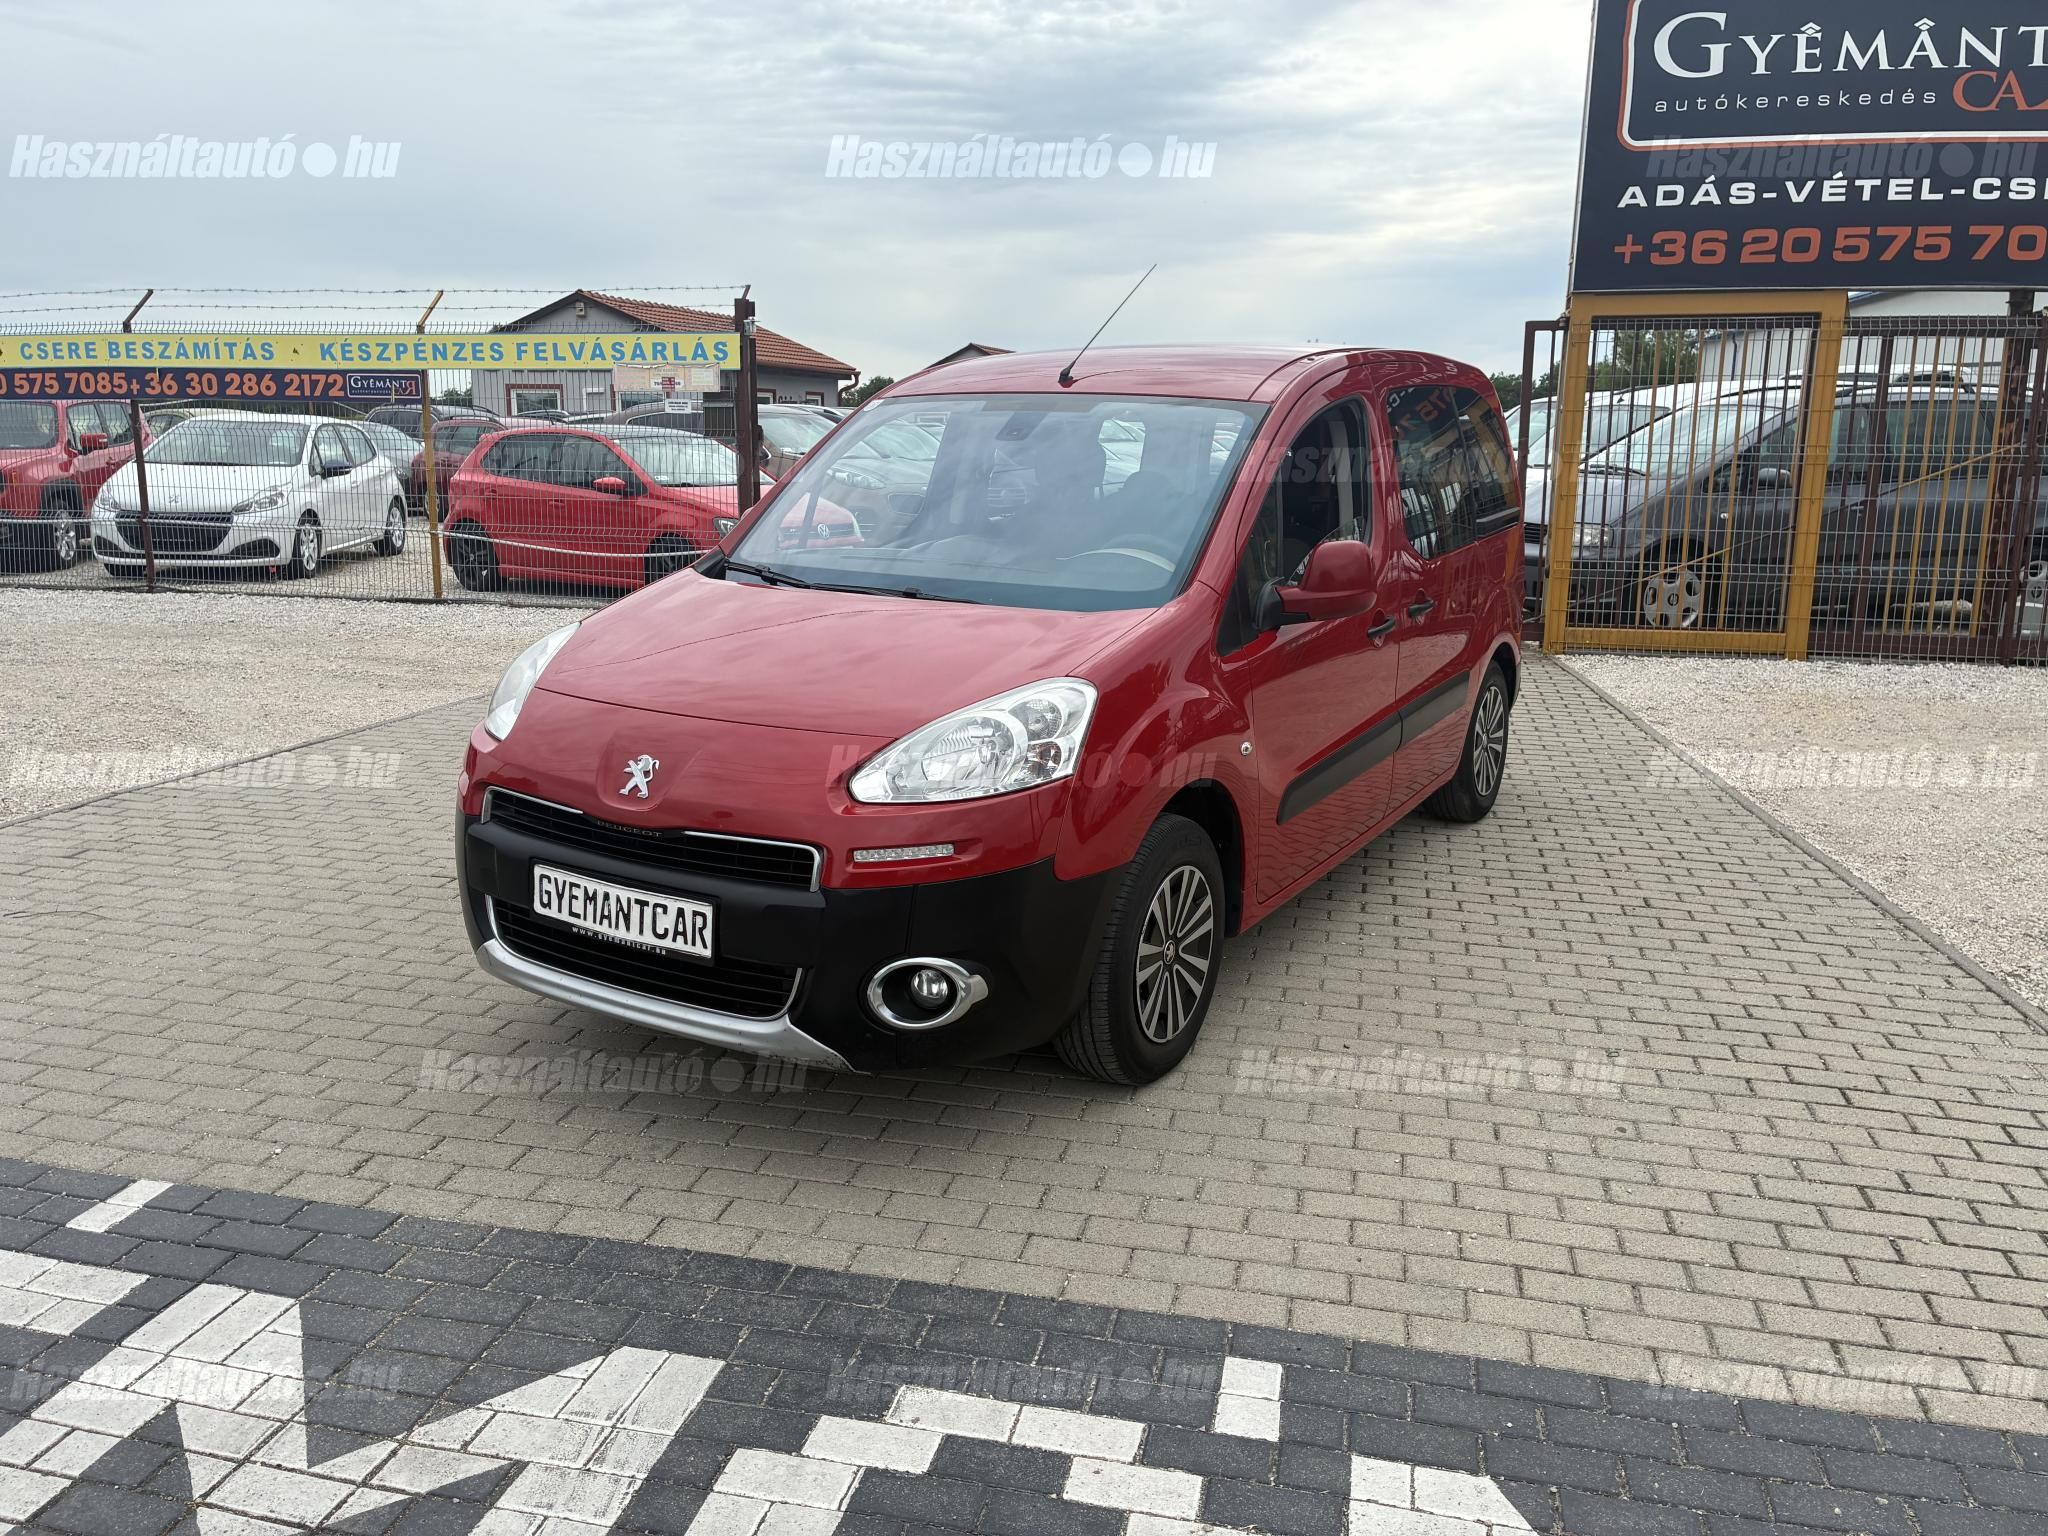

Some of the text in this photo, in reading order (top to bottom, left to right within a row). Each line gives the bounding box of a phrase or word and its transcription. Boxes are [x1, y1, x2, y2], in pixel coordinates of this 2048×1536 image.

[1655, 89, 1937, 112] autókereskedés
[1617, 170, 2048, 209] ADÁS-VÉTEL-CS
[1614, 230, 1727, 266] +36
[1740, 227, 1821, 264] 20
[1833, 225, 1952, 262] 575
[20, 337, 275, 361] CSERE BESZÁMÍTÁS
[319, 337, 729, 362] KÉSZPÉNZES FELVÁSÁRLÁS
[14, 373, 60, 394] 575
[185, 373, 218, 395] 30
[224, 373, 277, 396] 286
[284, 374, 344, 397] 2172
[538, 873, 709, 949] GYEMANTCAR
